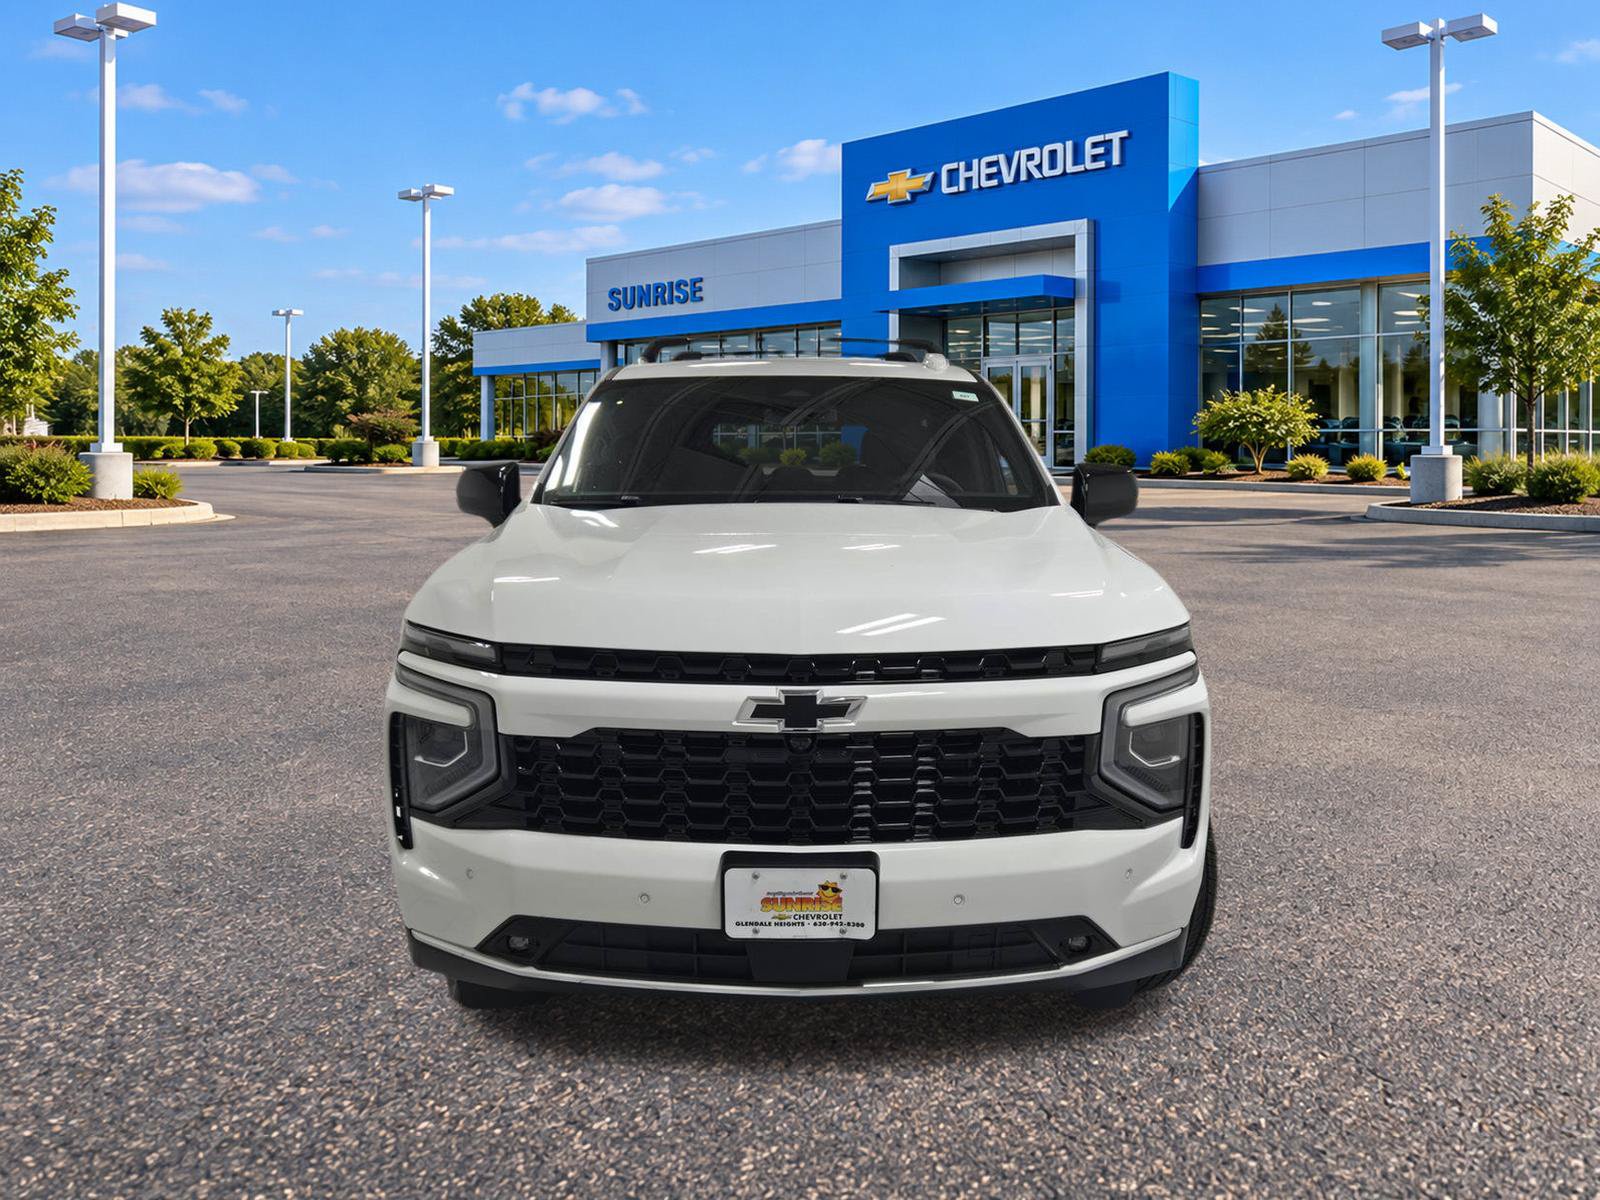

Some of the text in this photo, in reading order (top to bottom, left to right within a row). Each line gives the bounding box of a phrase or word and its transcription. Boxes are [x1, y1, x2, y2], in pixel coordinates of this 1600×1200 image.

[941, 130, 1128, 194] CHEVROLET
[607, 277, 704, 311] SUNRISE
[760, 897, 843, 912] SUNRISE
